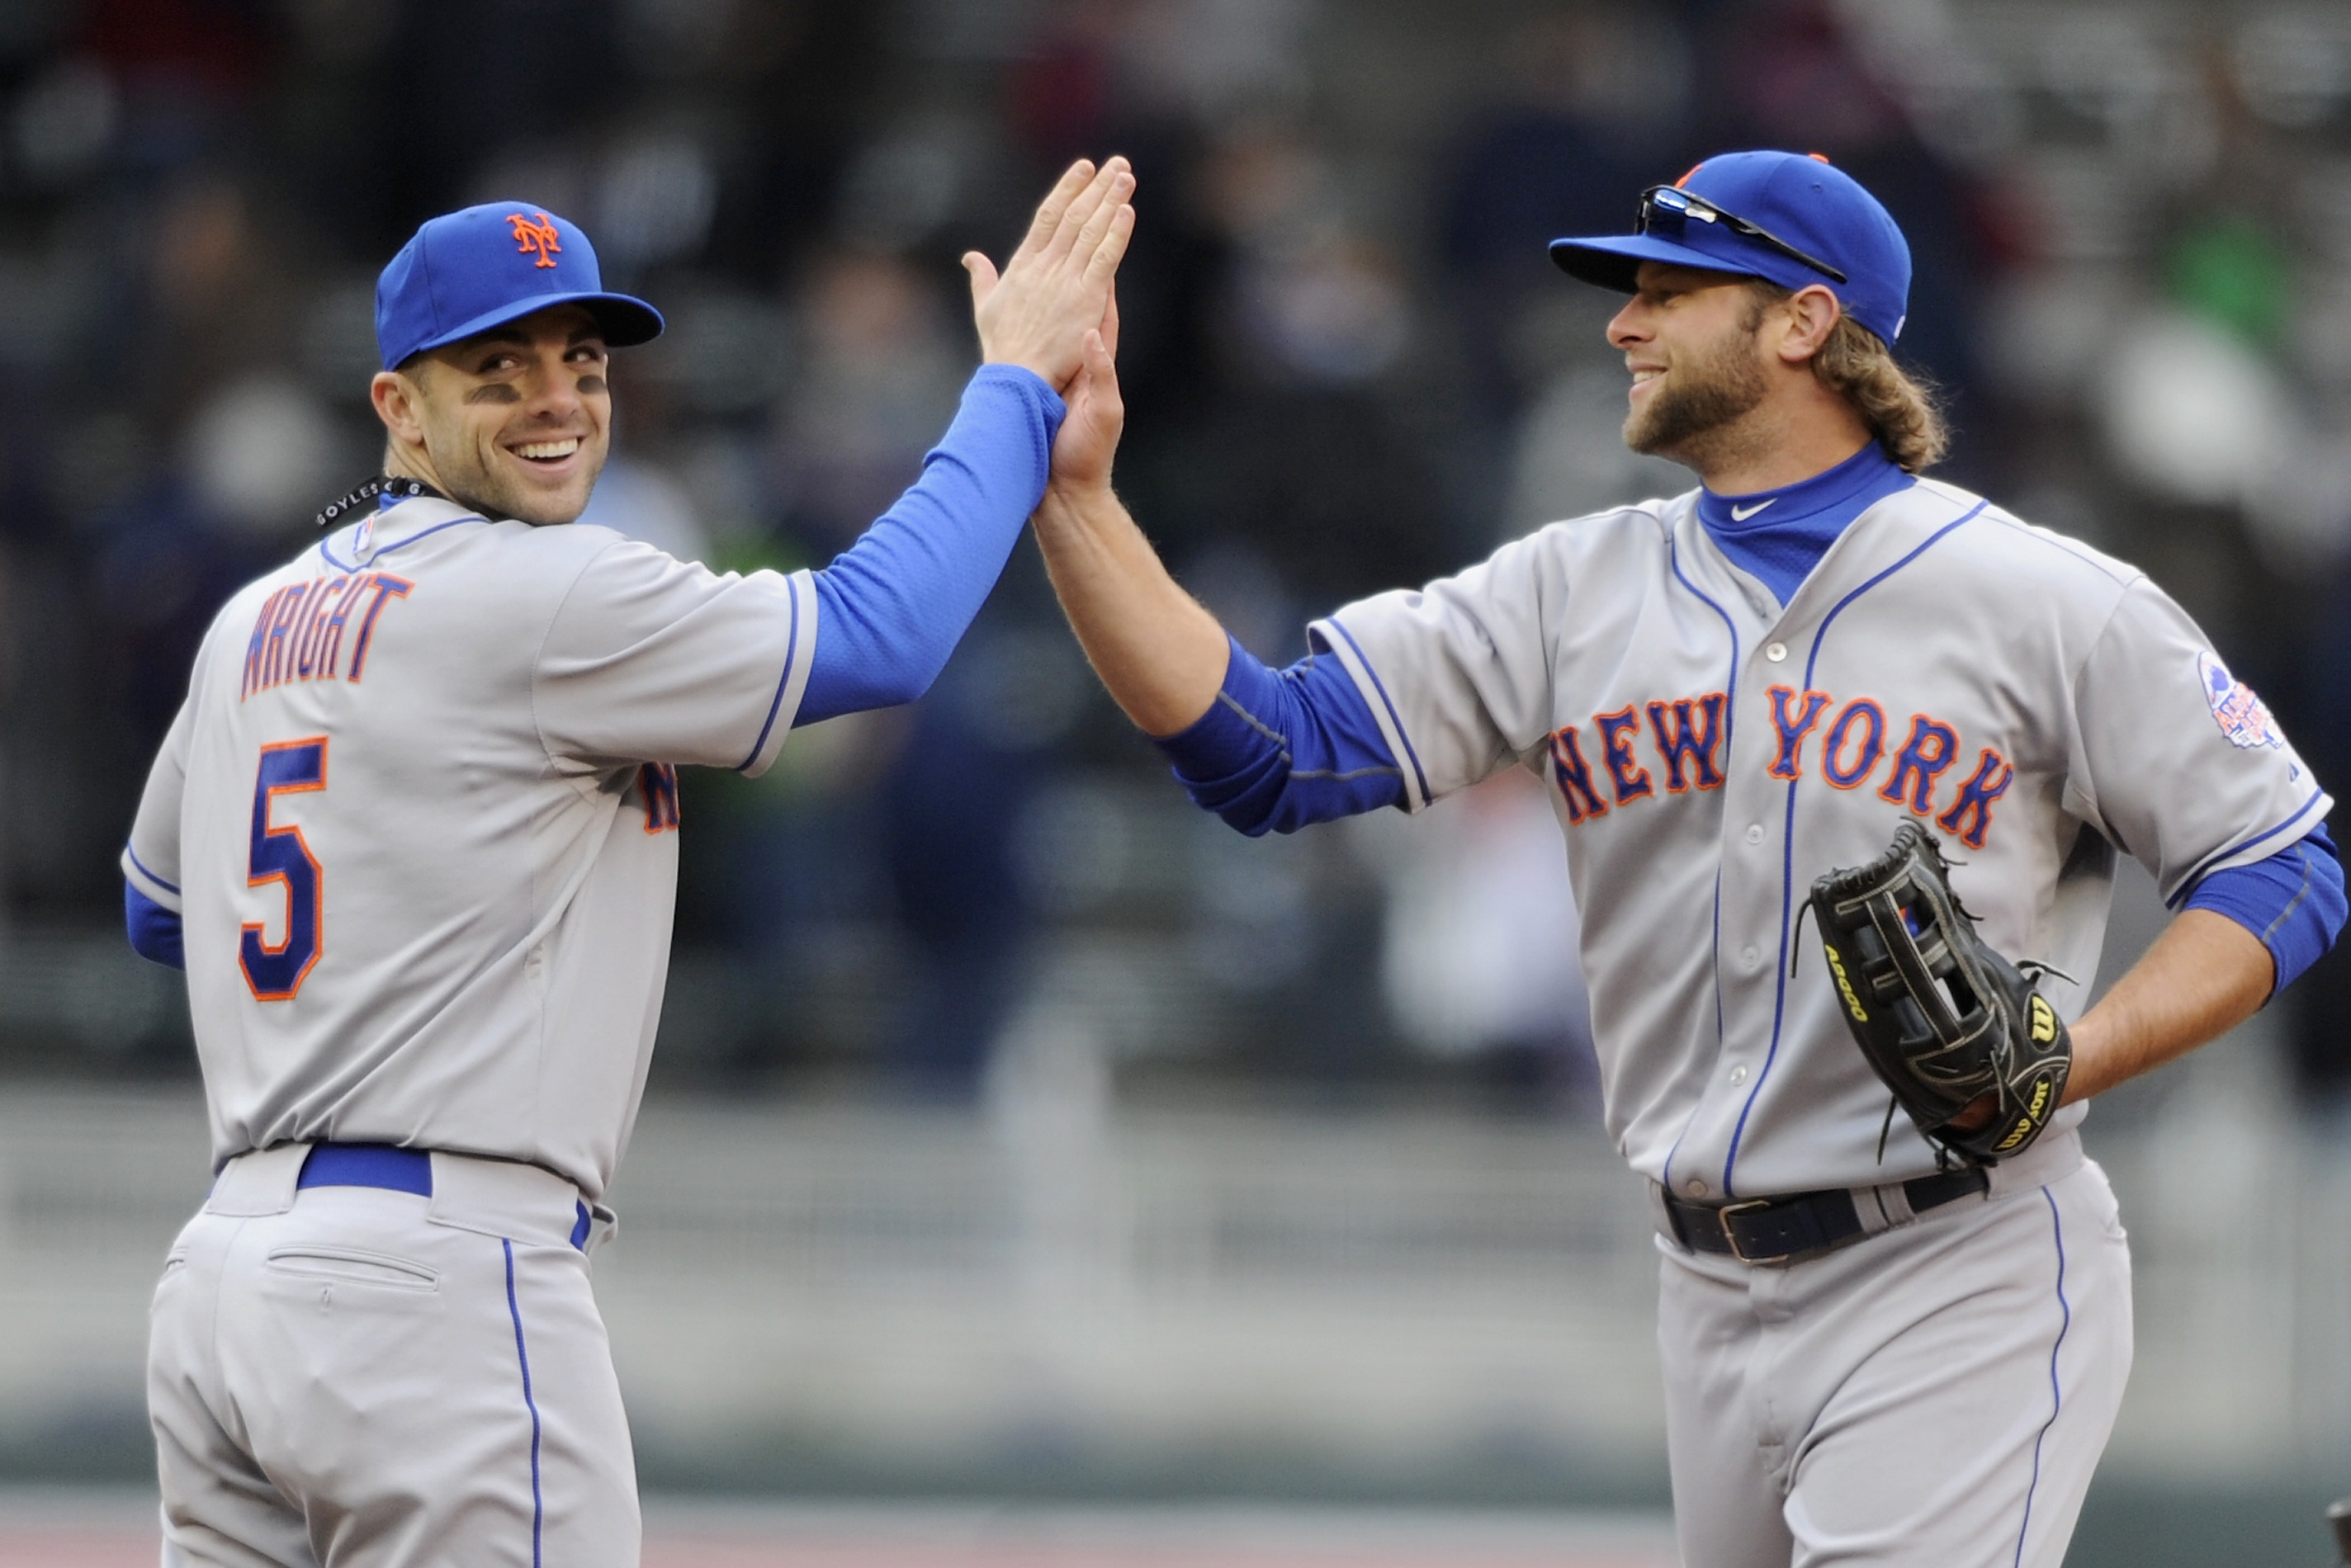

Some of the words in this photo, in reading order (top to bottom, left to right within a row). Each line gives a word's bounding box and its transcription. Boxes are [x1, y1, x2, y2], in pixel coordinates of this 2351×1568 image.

[240, 572, 416, 702] WRIGHT
[1548, 692, 1729, 826] NEW
[1764, 684, 2014, 851] YORK
[238, 735, 329, 1002] 5
